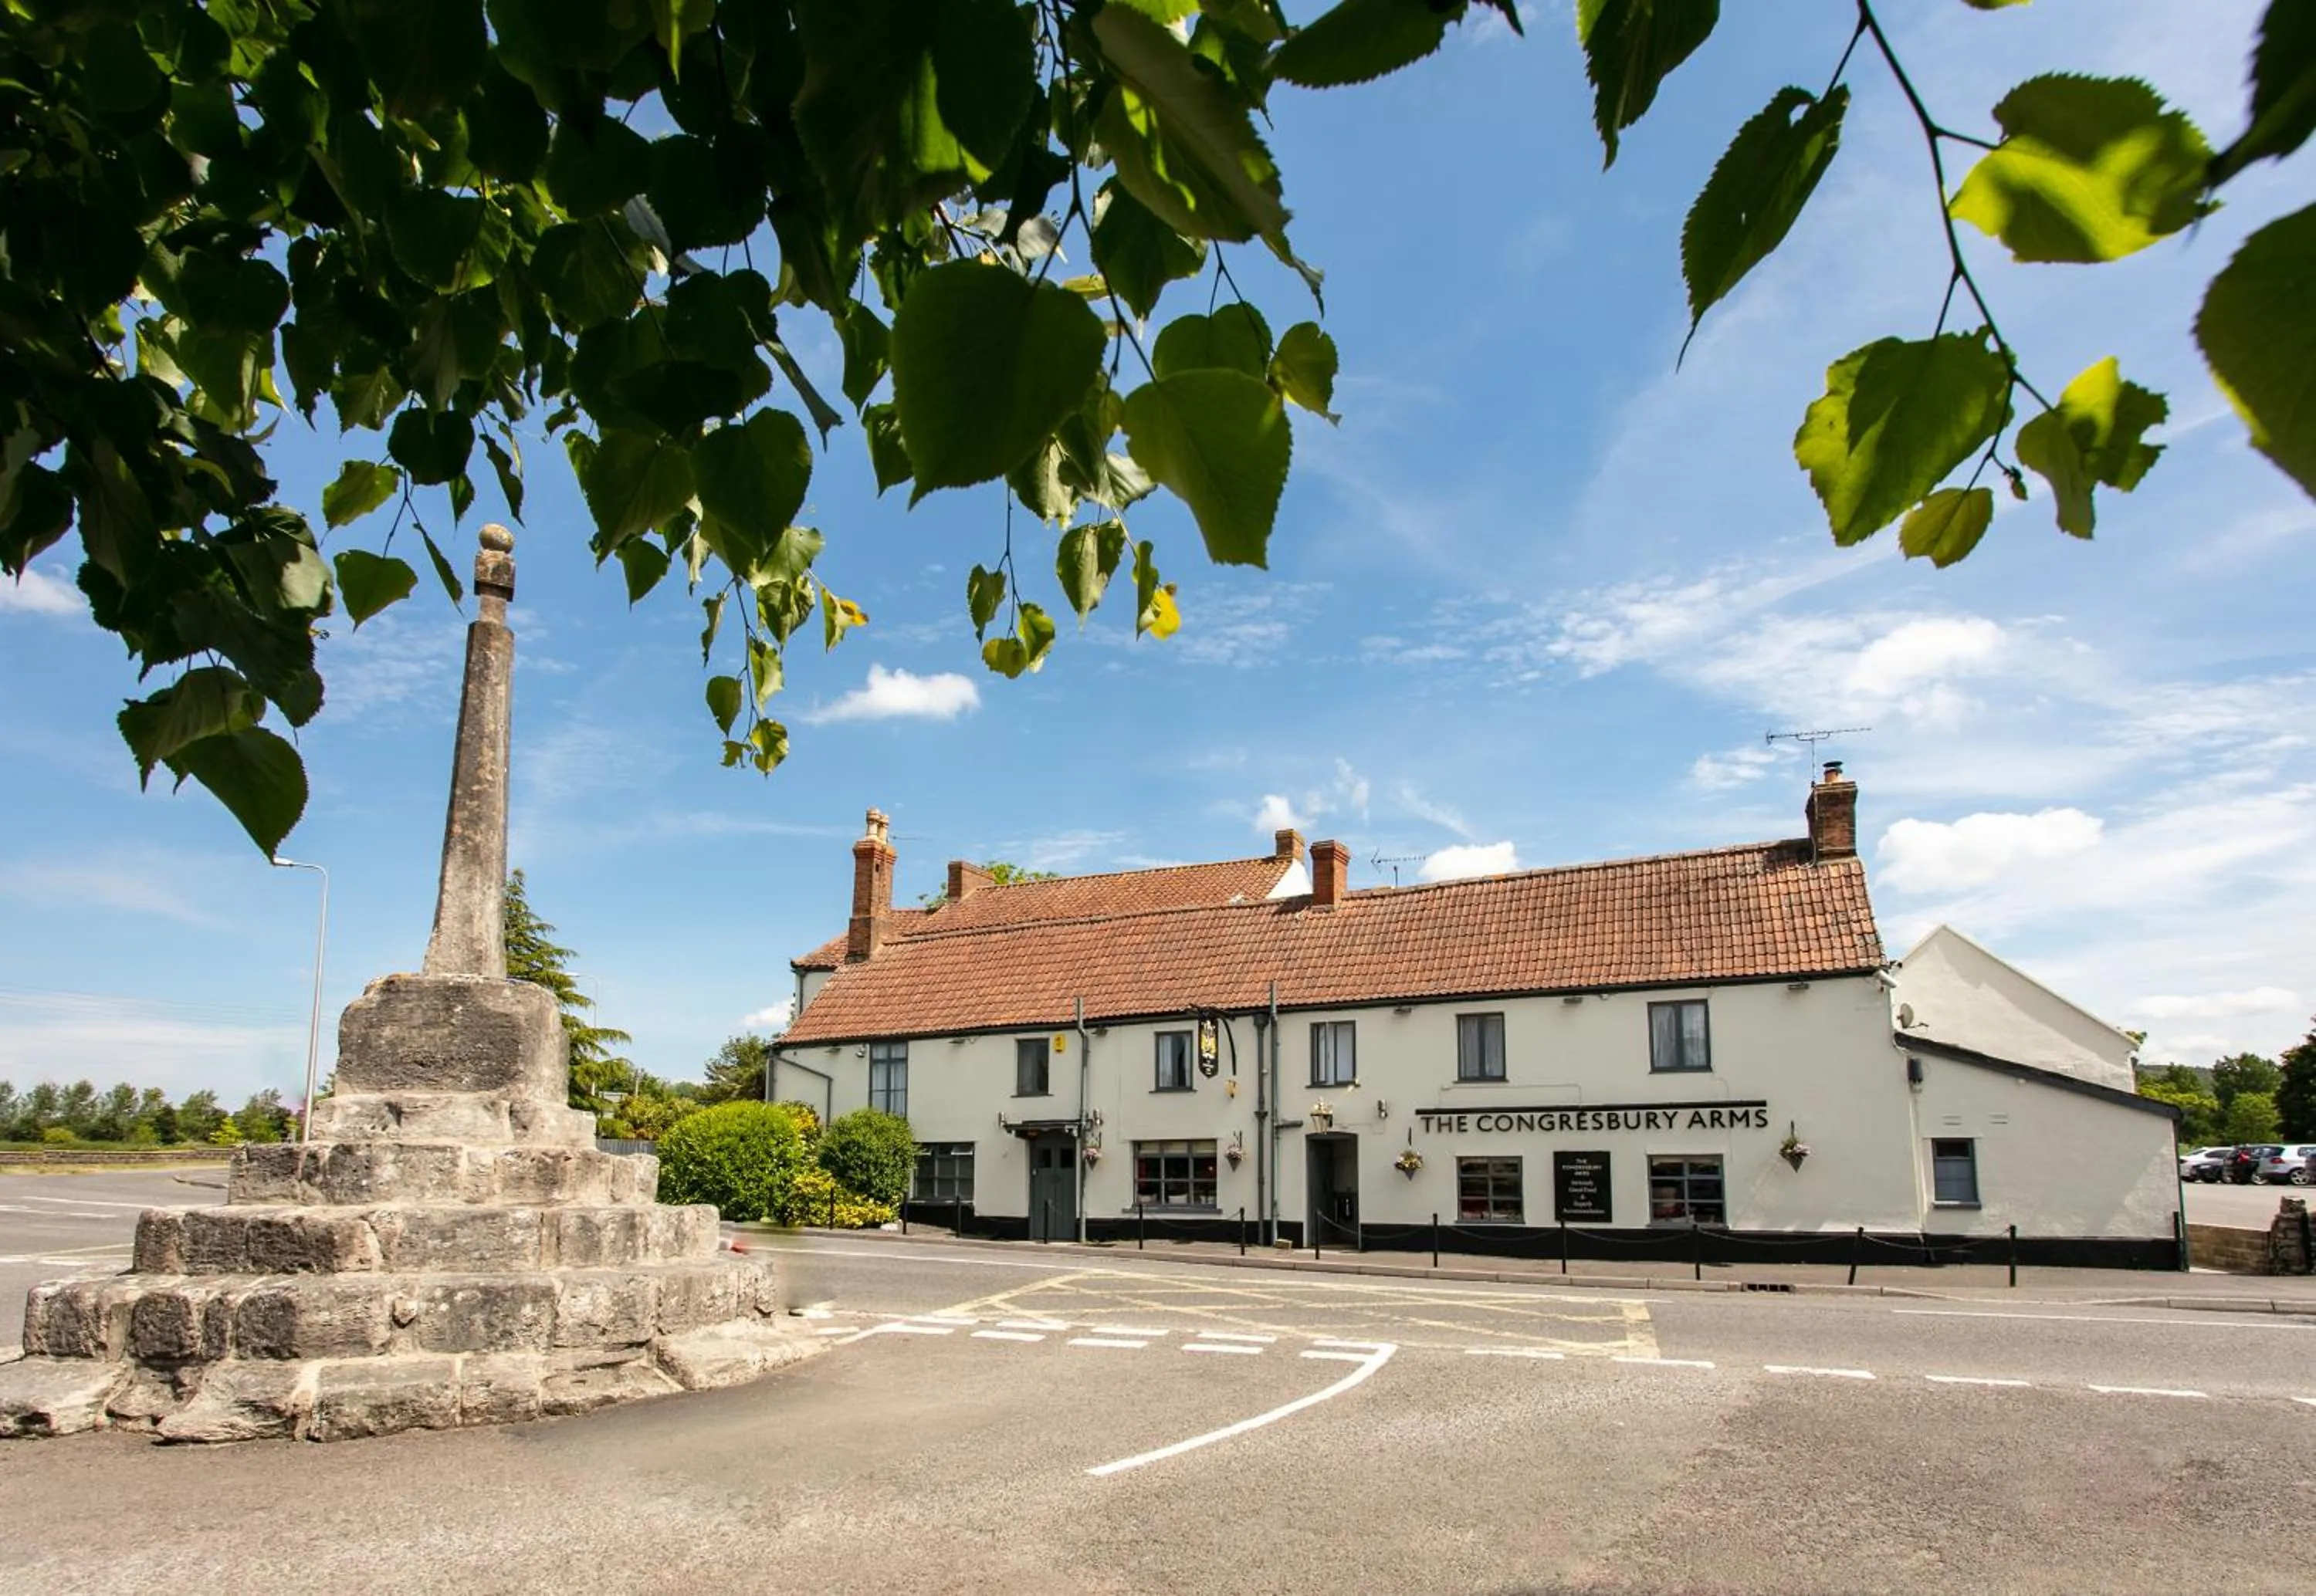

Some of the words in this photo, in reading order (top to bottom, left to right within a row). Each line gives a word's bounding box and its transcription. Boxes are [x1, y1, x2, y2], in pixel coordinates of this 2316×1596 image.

[1420, 1115, 1468, 1134] THE
[1477, 1111, 1678, 1132] CONGRESBURY
[1688, 1108, 1769, 1128] ARMS
